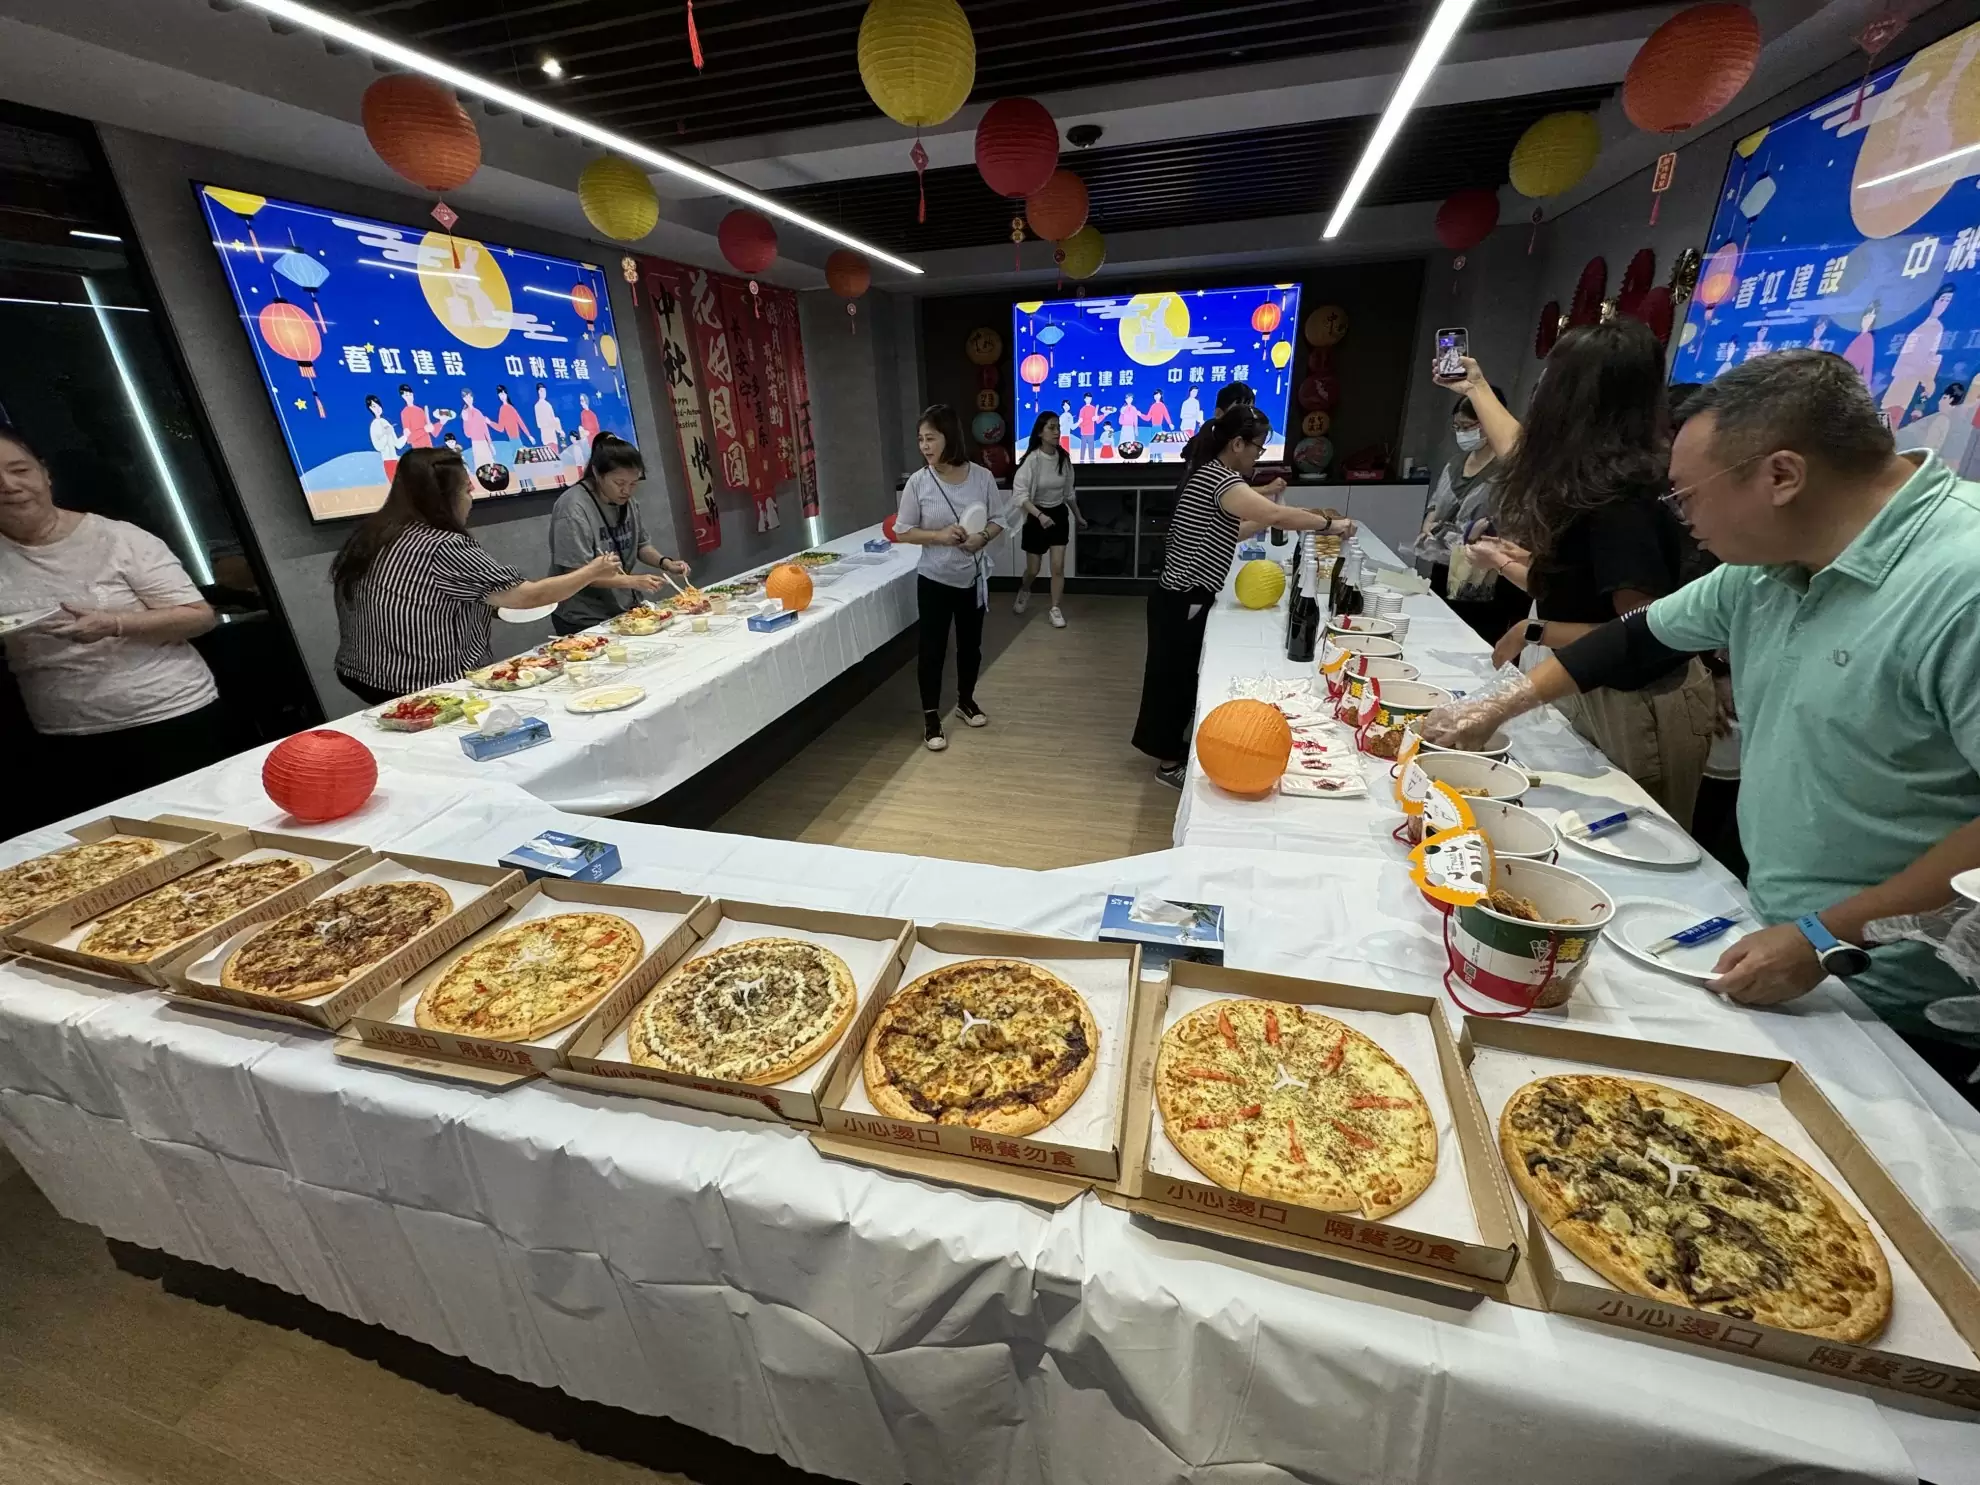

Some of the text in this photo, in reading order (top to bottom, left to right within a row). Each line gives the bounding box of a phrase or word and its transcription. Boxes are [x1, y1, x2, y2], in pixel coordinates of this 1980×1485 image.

[1731, 254, 1849, 310] 春虹建設
[343, 345, 591, 381] 春虹建設 中秋聚餐
[1057, 364, 1249, 388] 春虹建設 中秋聚餐
[370, 1027, 536, 1067] 小心燙口 隔餐勿食
[843, 1117, 1076, 1169] 小心燙口 隔餐勿食
[1166, 1183, 1461, 1265] 小心燙口 隔餐勿食
[1597, 1298, 1764, 1350] 小心燙口
